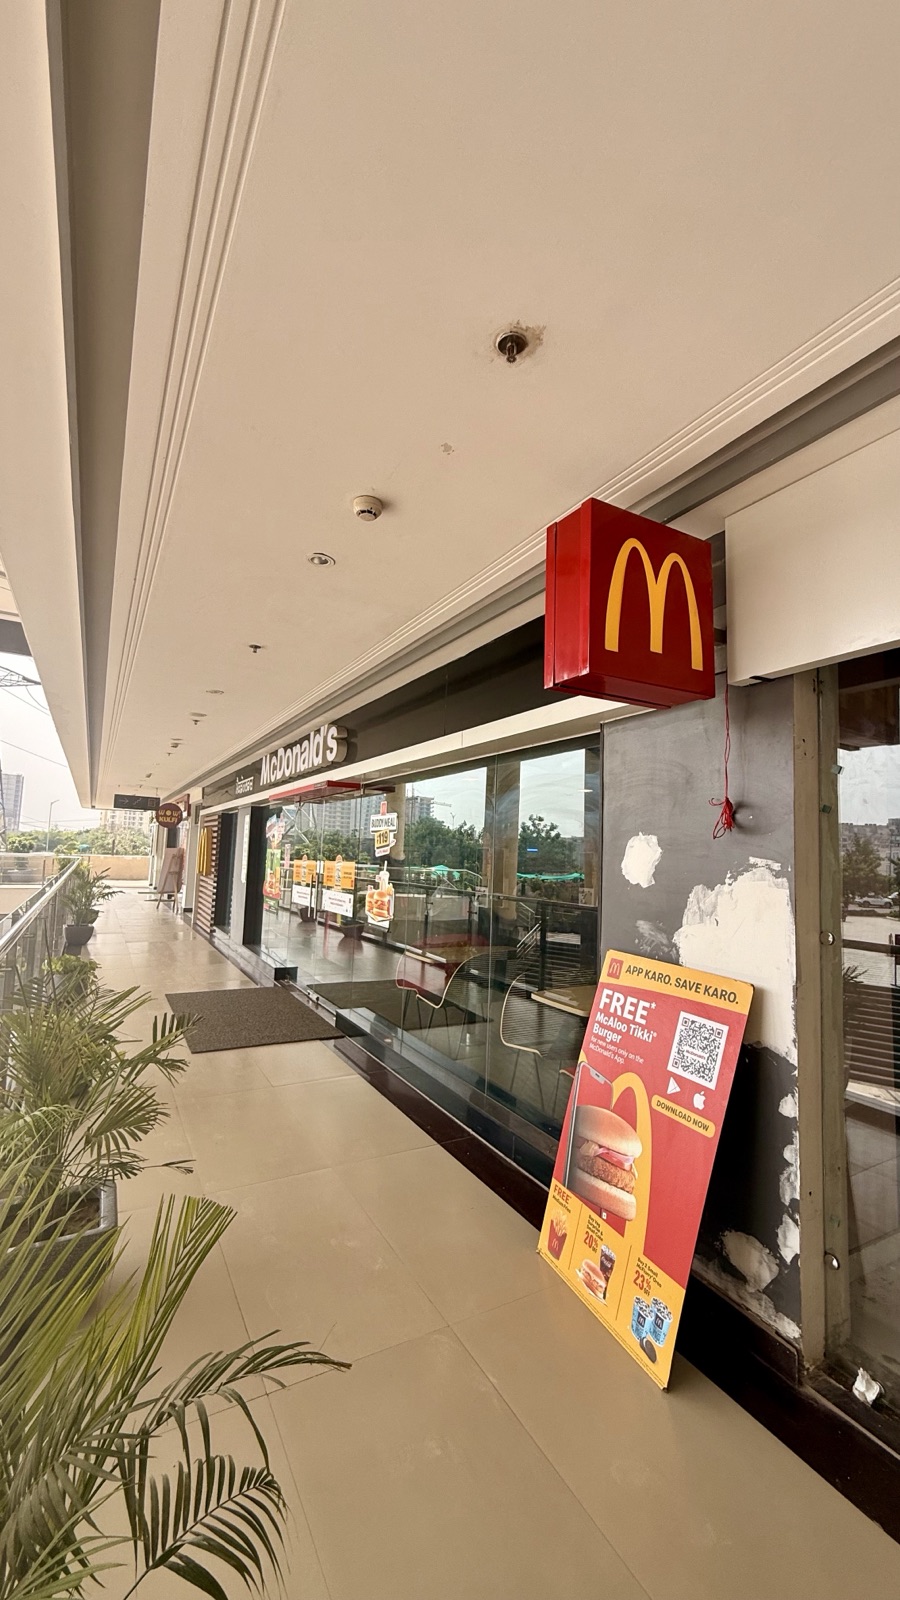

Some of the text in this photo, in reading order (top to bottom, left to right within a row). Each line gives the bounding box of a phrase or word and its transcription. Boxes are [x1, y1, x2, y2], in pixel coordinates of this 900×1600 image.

[259, 723, 339, 786] McDonald's
[625, 964, 739, 1005] APP KARO. SAVE KARO.
[592, 1022, 623, 1044] Burger
[595, 1011, 628, 1033] McAloo
[589, 1042, 615, 1060] McDonald's
[596, 1039, 607, 1047] new
[606, 1043, 618, 1053] users
[617, 1048, 629, 1058] only
[628, 1052, 635, 1060] on
[635, 1055, 645, 1065] the
[656, 1099, 710, 1132] DOWNLOAD NOW
[583, 1230, 599, 1249] 20%
[633, 1270, 652, 1291] 23%
